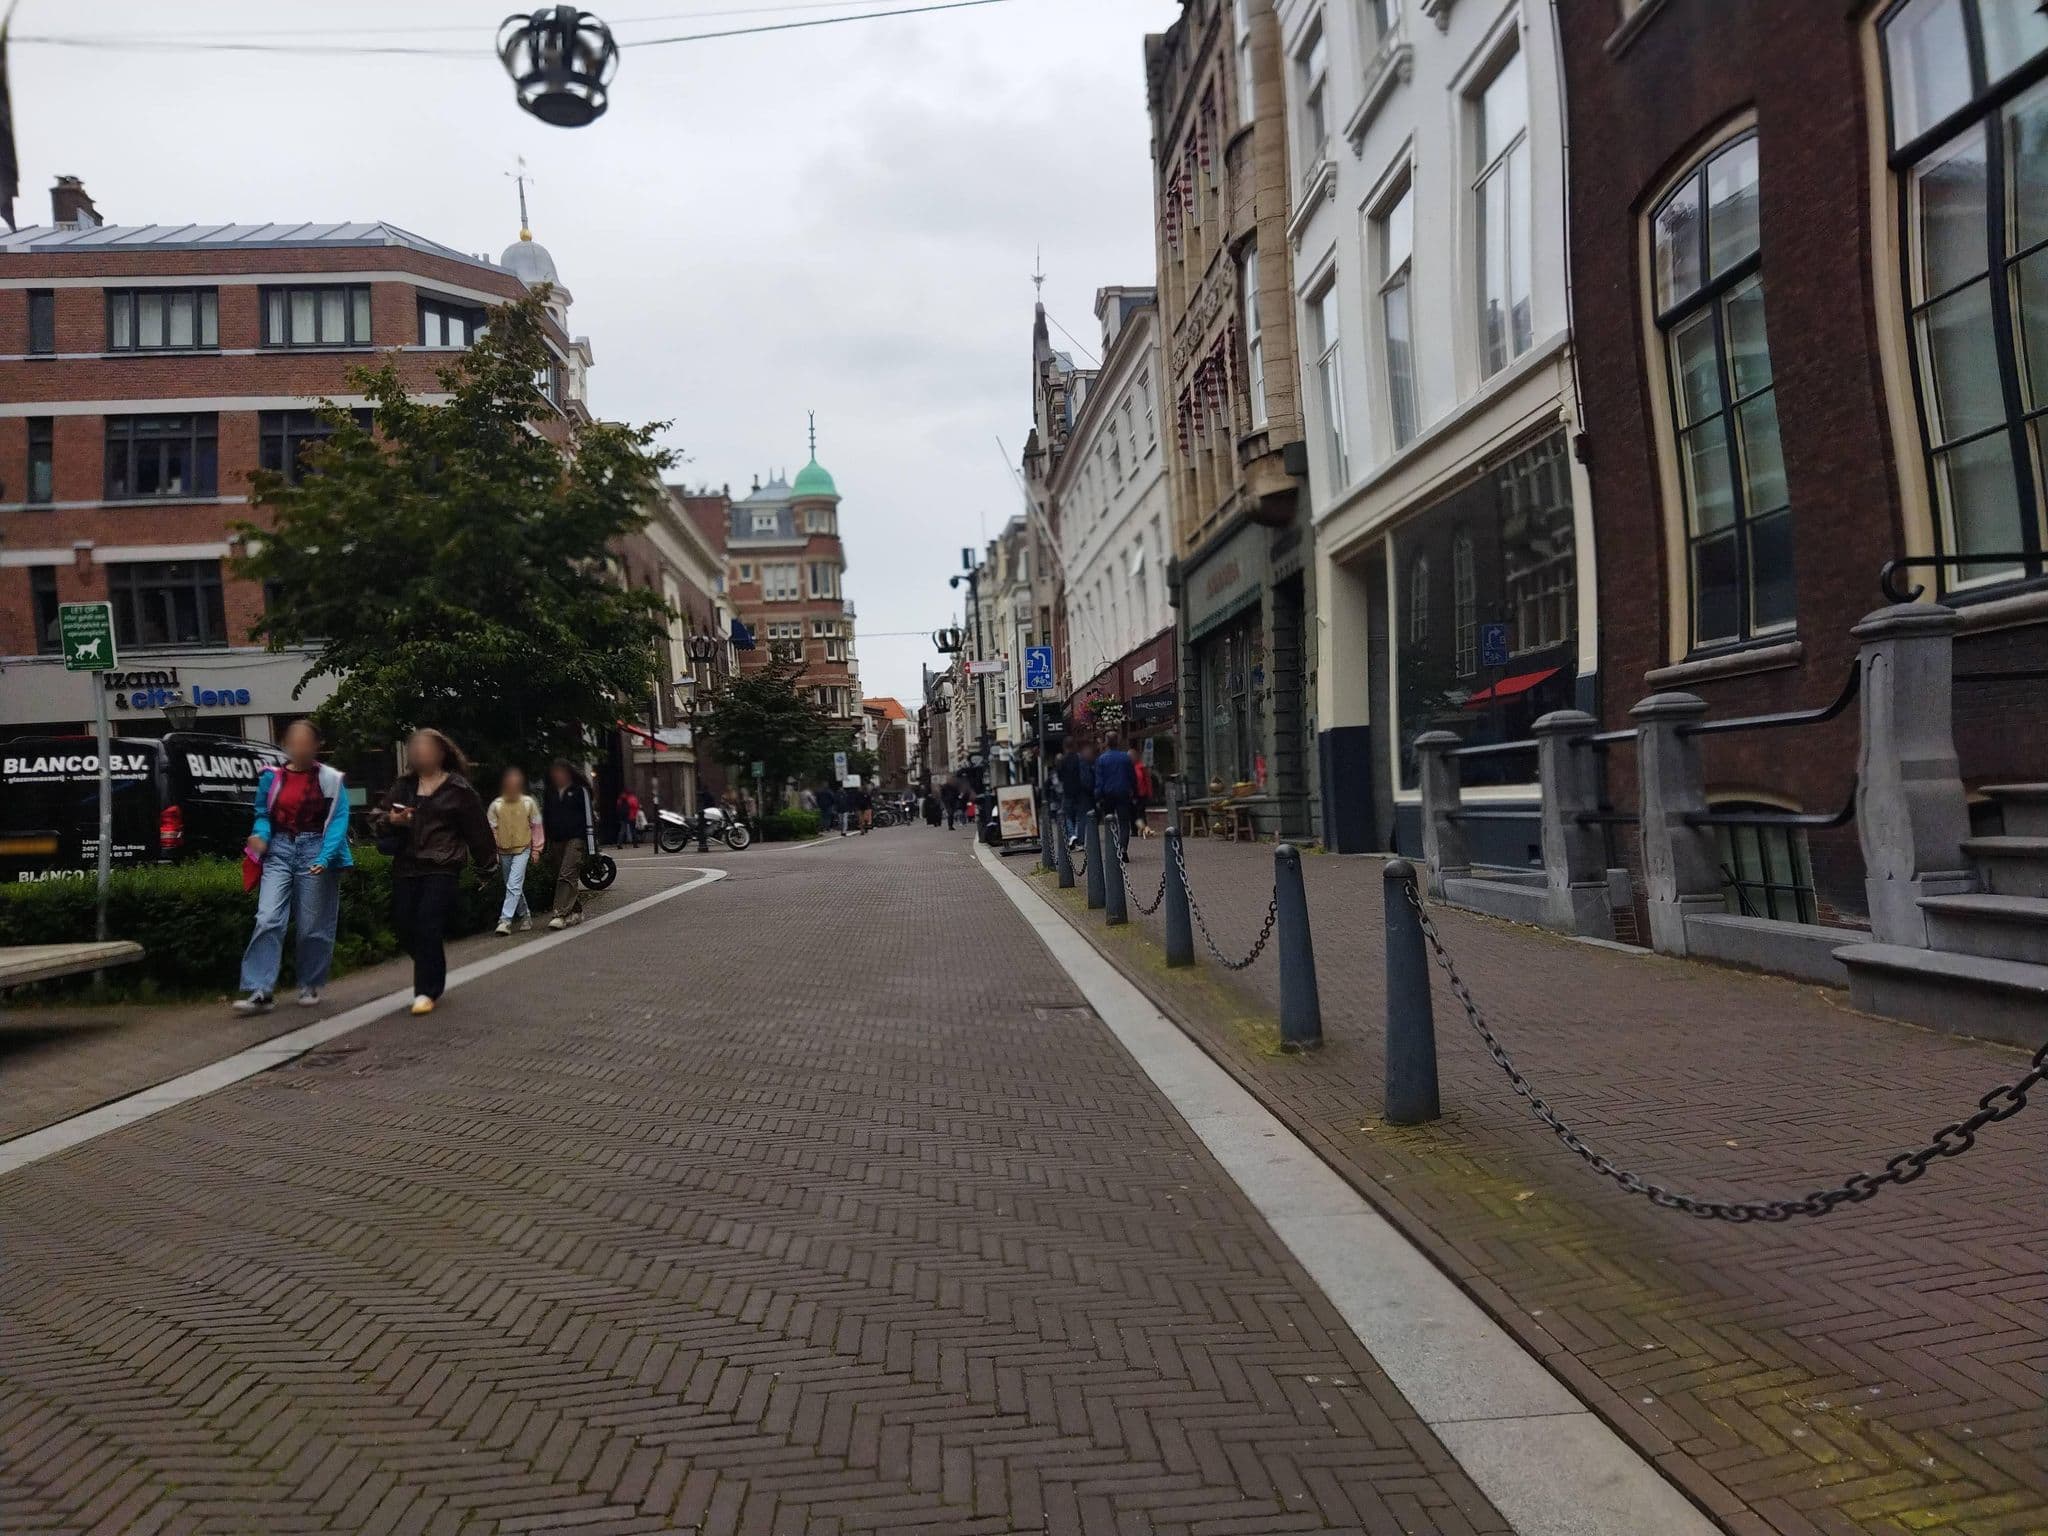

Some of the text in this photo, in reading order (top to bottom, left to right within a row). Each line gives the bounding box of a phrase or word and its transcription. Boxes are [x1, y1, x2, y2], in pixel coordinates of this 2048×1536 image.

[115, 693, 129, 709] &
[192, 685, 251, 706] lens
[3, 755, 149, 774] BLANCO B.V.
[186, 754, 254, 779] BLANCO
[18, 869, 85, 883] BLANCO
